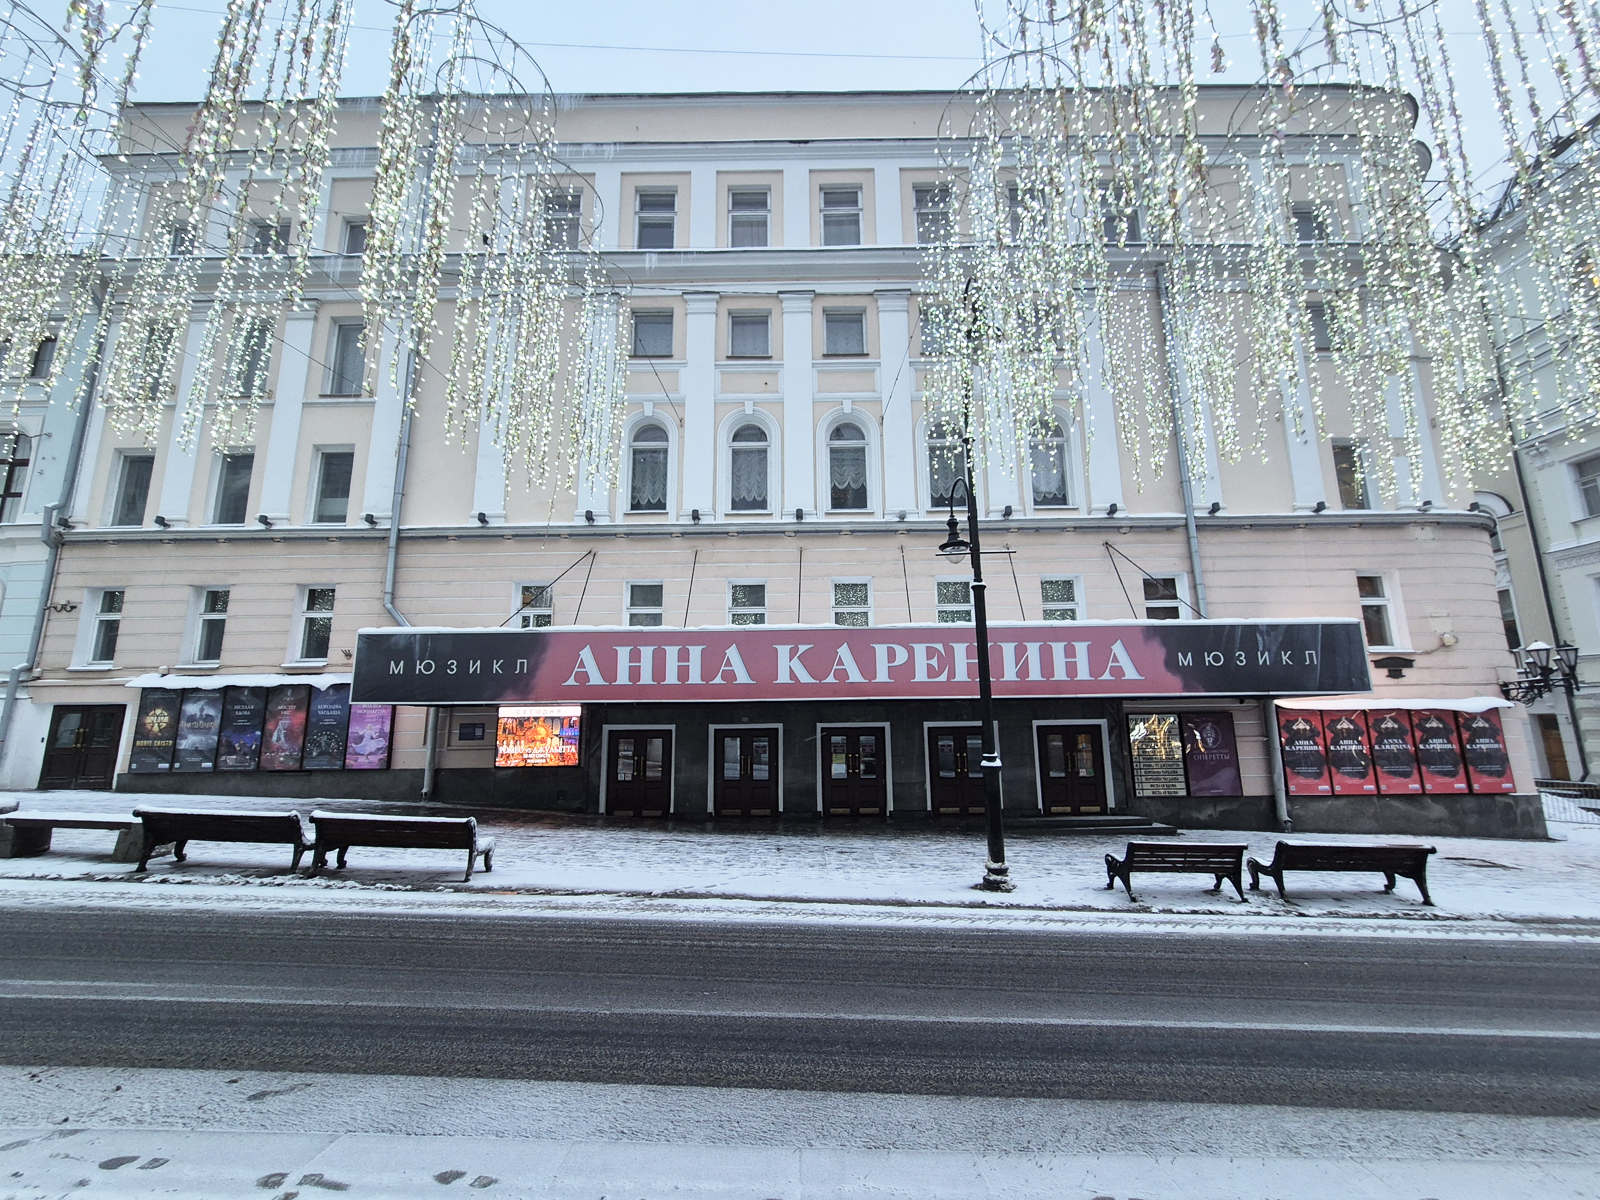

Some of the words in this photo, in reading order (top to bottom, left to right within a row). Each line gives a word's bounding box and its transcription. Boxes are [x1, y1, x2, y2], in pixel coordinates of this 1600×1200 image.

[389, 658, 529, 676] МЮЗИКЛ
[561, 642, 756, 687] АННА
[772, 639, 1146, 685] КАРЕНИНА
[1178, 650, 1319, 667] МЮЗИКЛ
[532, 745, 576, 754] ДЖУЛЬЕТТА
